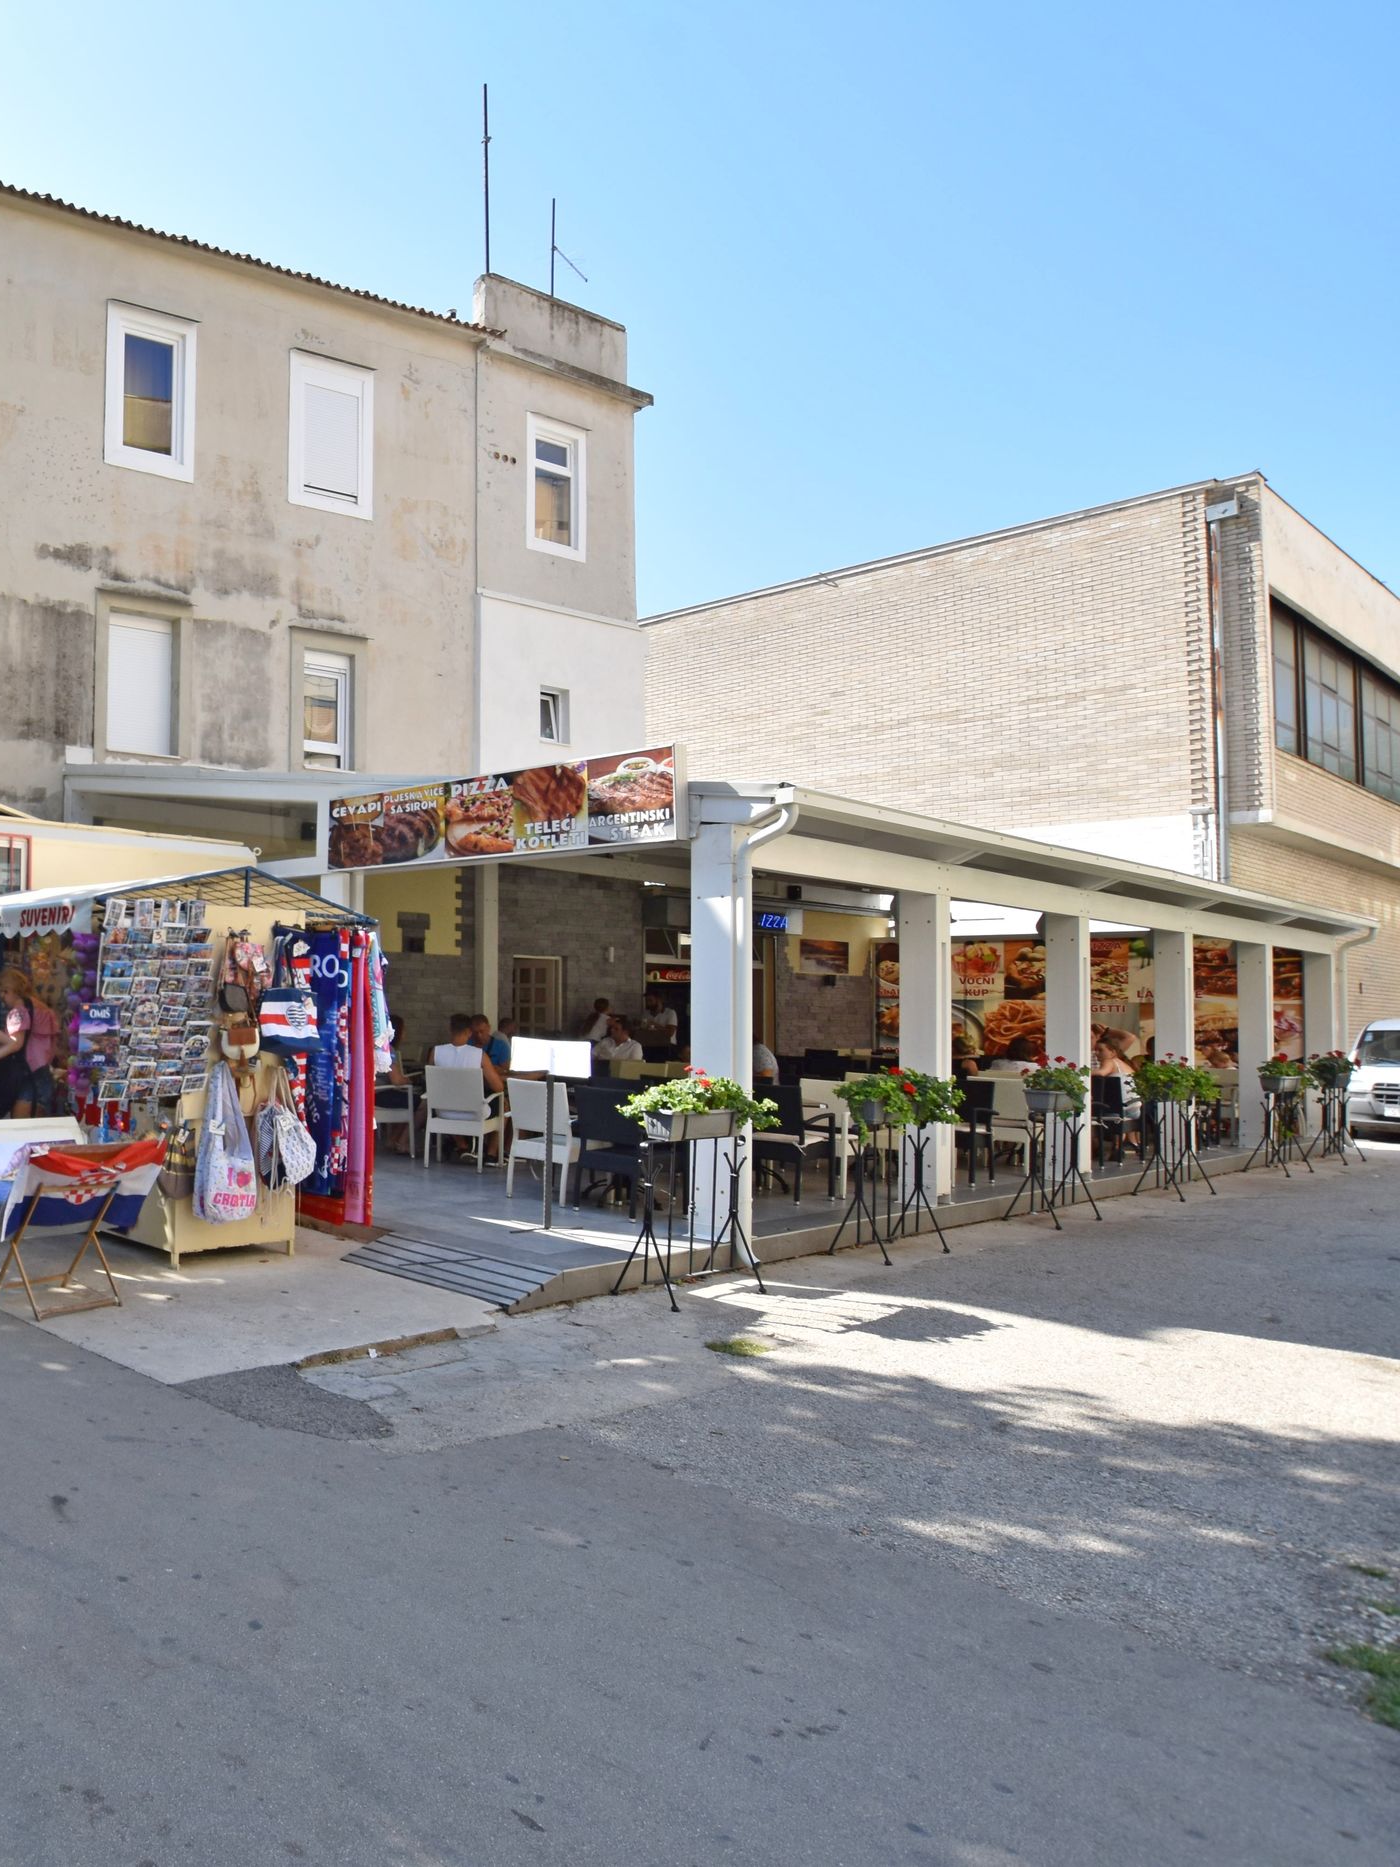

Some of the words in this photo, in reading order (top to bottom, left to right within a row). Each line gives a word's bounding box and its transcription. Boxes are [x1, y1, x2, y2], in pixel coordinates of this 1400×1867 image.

[451, 777, 509, 797] PIZZA
[524, 813, 576, 834] TELEĆI
[589, 808, 670, 827] ARGENTINSKI
[610, 822, 666, 840] STEAK
[516, 831, 586, 850] KOTLETI
[19, 905, 76, 928] SUVENIRI
[761, 913, 788, 928] IZZA
[1092, 942, 1122, 951] IZZA
[965, 989, 989, 997] KUP
[1091, 1004, 1127, 1013] GETTI
